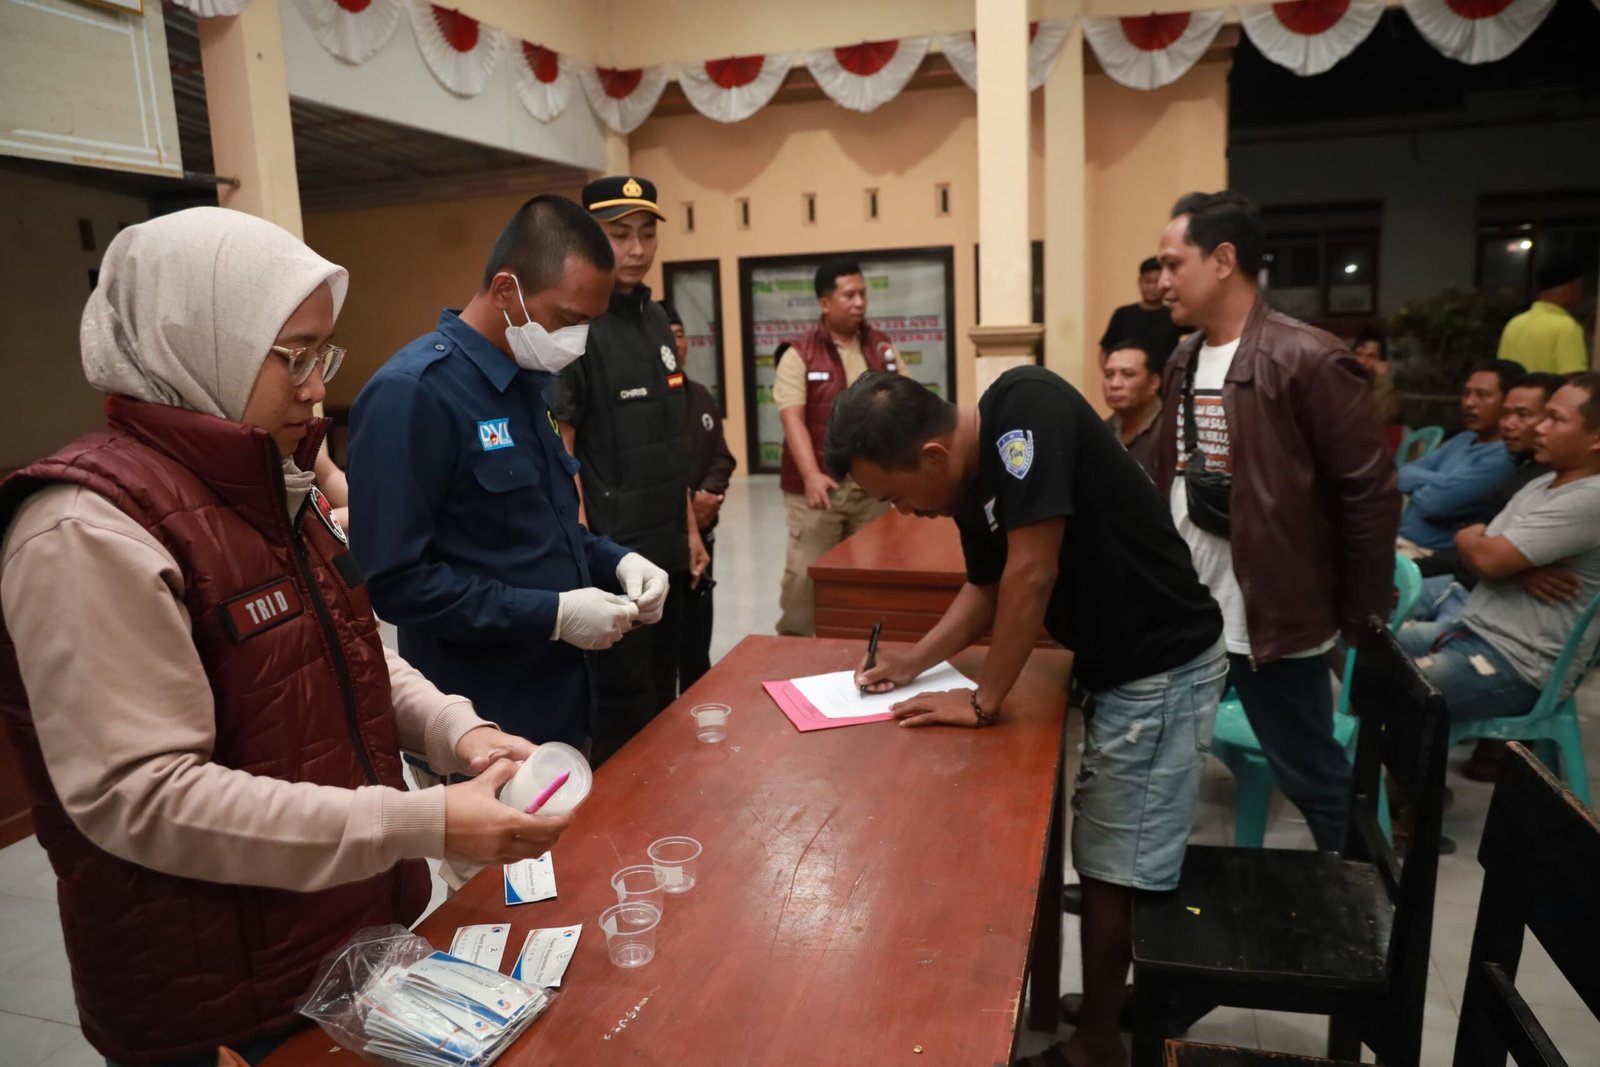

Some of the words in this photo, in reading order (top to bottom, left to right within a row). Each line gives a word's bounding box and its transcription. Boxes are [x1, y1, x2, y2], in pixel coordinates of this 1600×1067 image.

[620, 387, 648, 399] CHRIS
[480, 422, 509, 443] DVI
[245, 595, 277, 624] TRI
[274, 590, 289, 613] D
